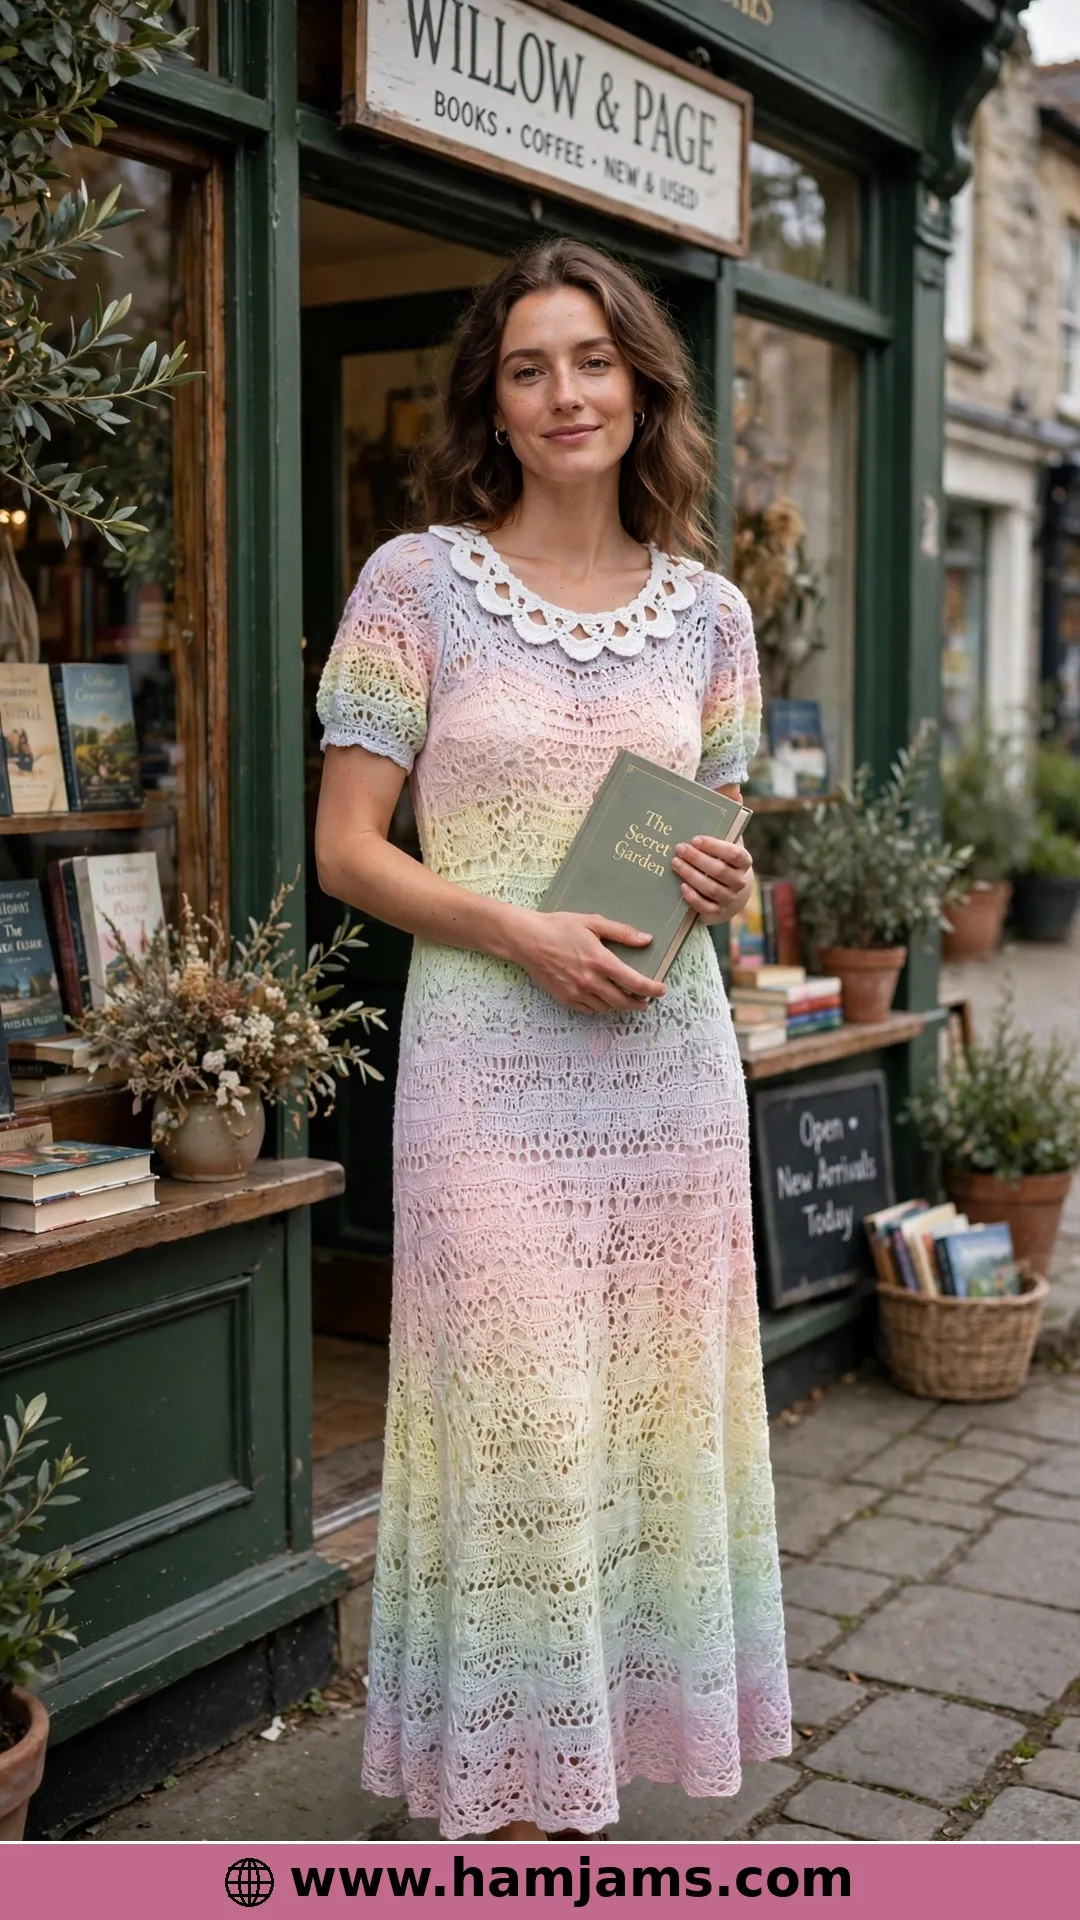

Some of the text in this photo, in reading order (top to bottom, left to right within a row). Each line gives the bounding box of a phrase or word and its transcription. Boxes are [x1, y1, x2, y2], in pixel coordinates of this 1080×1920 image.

[407, 0, 718, 176] WILLOW & PAGE
[434, 89, 699, 212] BOOKS COFFEE NEW & USED
[625, 823, 672, 857] Secret
[645, 810, 673, 836] The
[612, 840, 665, 877] Garden
[799, 1111, 844, 1155] Open
[776, 1148, 877, 1200] New Arrivals
[800, 1199, 854, 1242] Today
